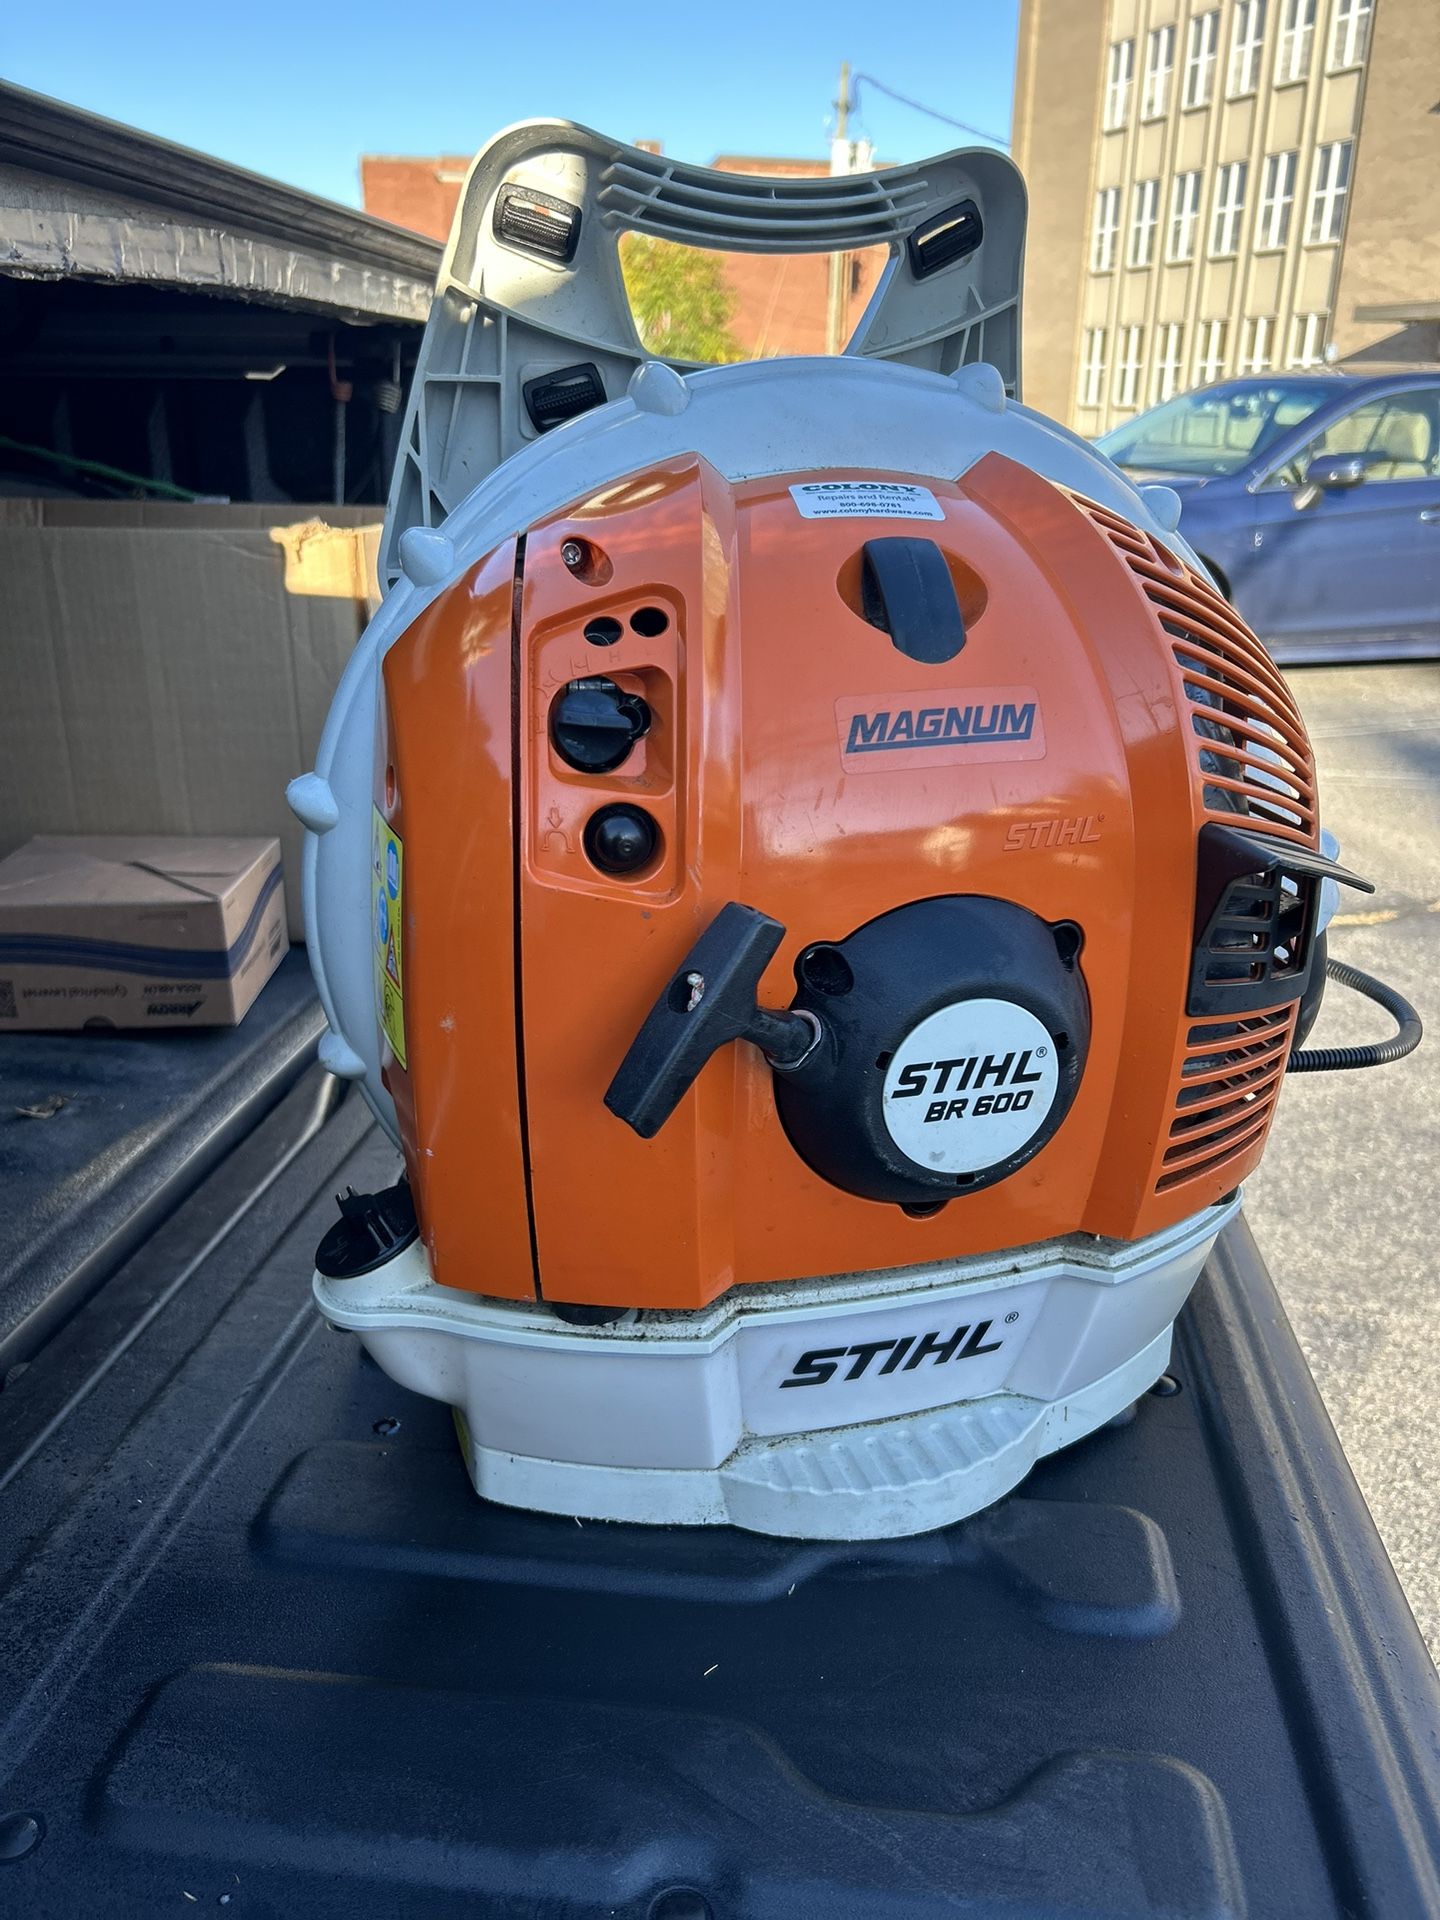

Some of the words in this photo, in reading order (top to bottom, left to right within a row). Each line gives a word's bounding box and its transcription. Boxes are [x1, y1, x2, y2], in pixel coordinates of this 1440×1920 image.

[802, 483, 917, 492] COLONY
[879, 494, 916, 502] Rentals
[813, 508, 933, 517] www.colonyhardware.com
[846, 703, 1036, 753] MAGNUM
[923, 1098, 969, 1123] BR
[972, 1089, 1034, 1116] 600
